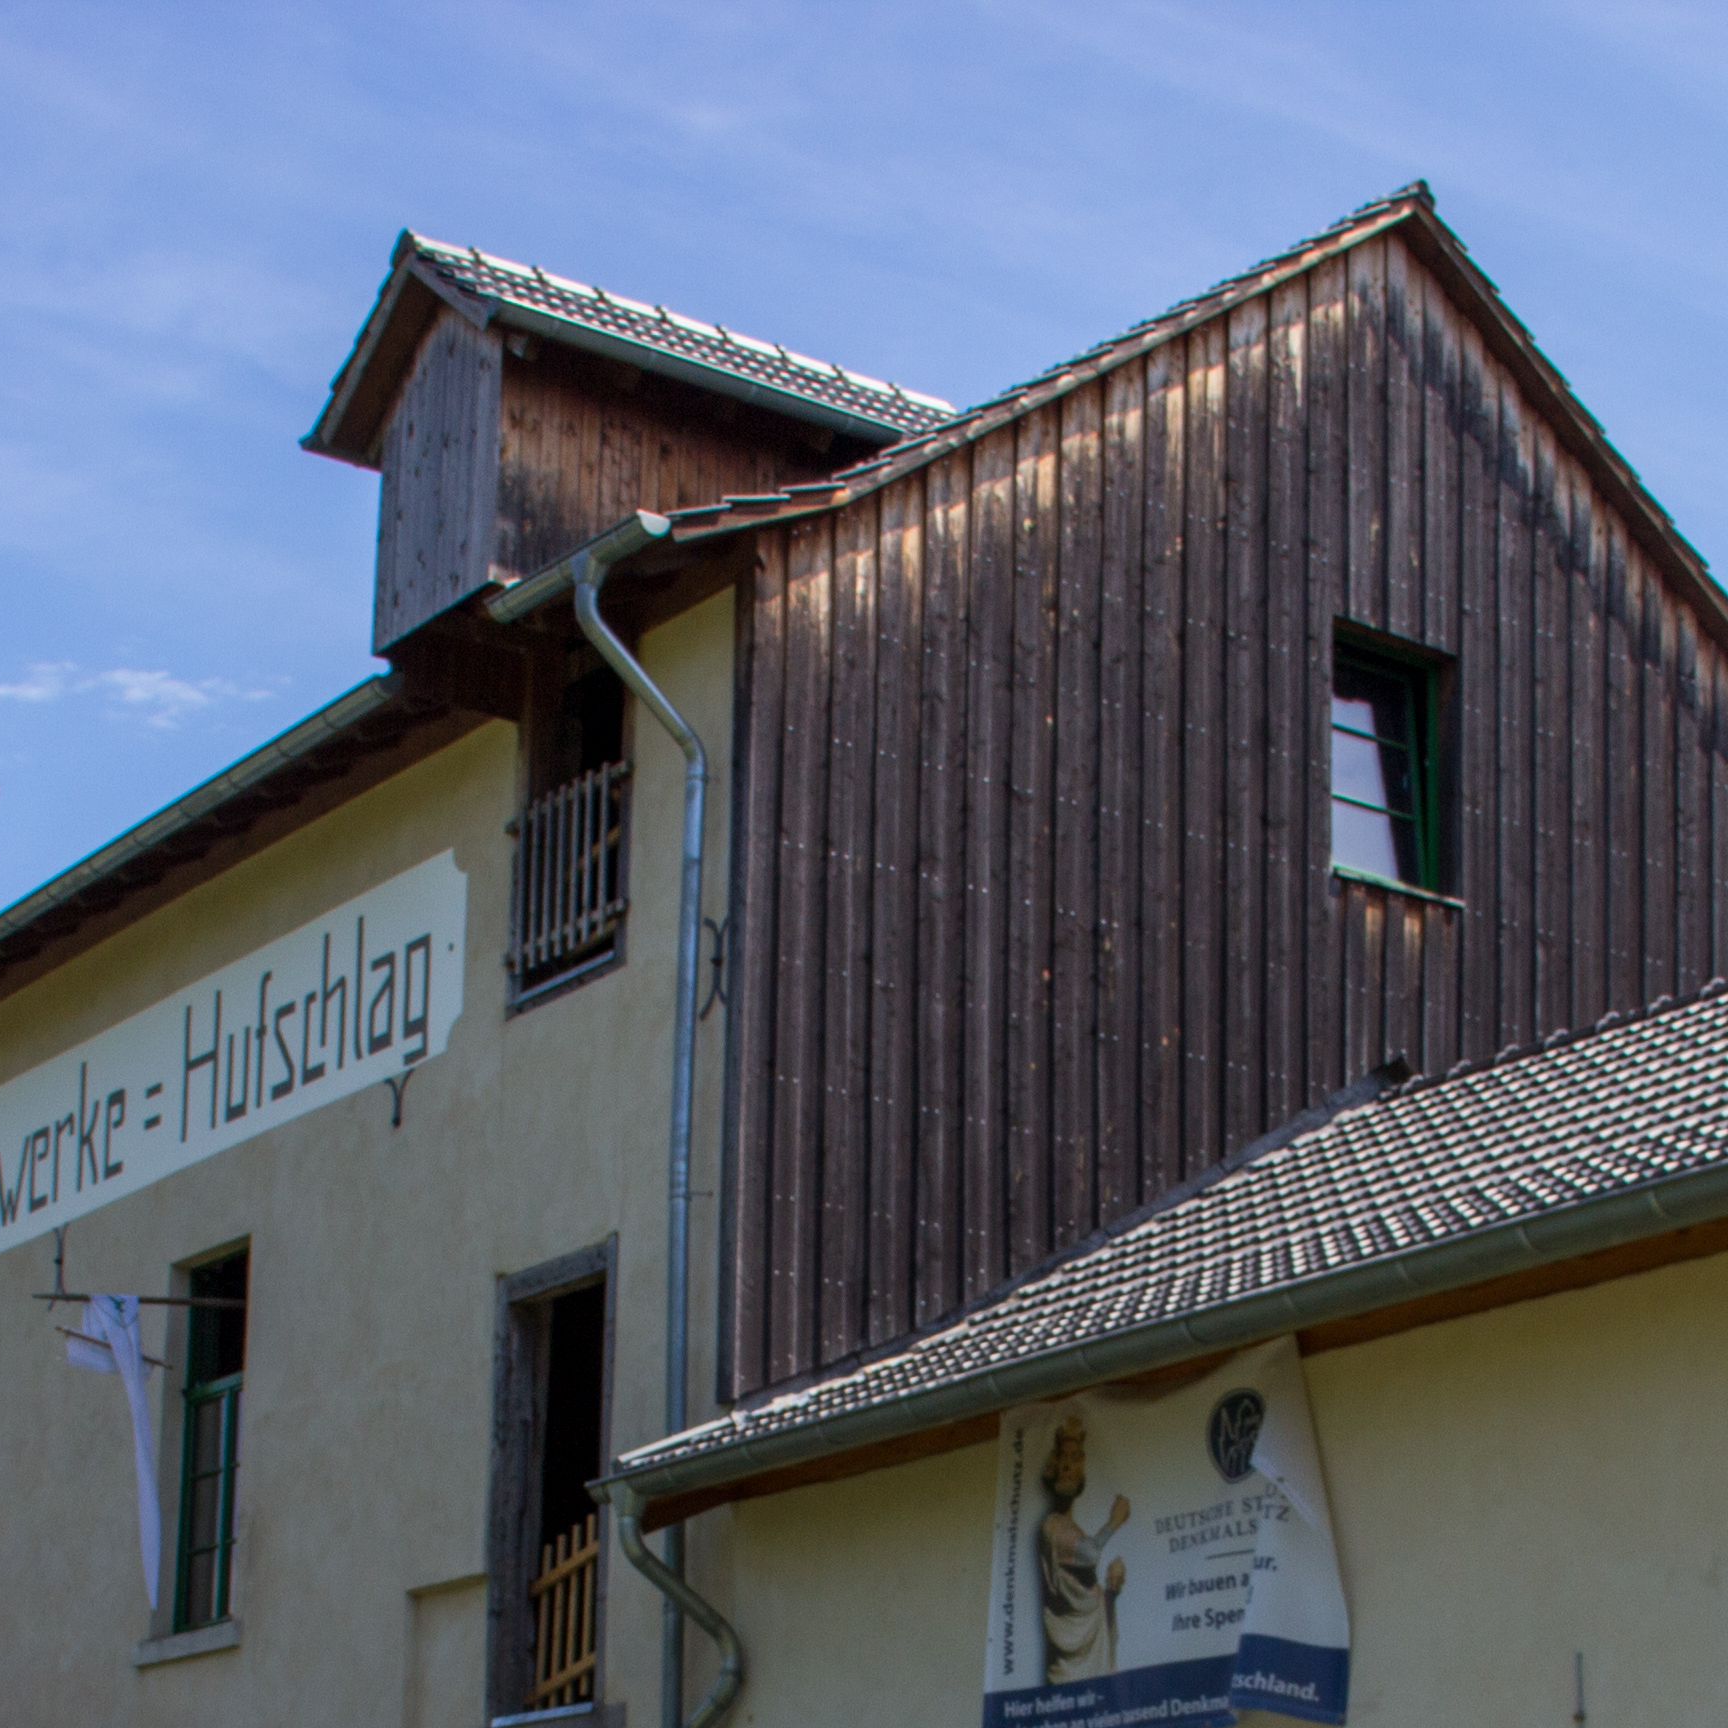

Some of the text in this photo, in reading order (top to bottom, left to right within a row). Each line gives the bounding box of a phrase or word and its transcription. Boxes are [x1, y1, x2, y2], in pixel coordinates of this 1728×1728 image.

[179, 915, 432, 1144] Hufschlag
[1003, 1428, 1023, 1676] www.denkmalschutz.de
[1188, 1573, 1237, 1596] bauen
[1004, 1700, 1032, 1718] Hier
[1035, 1694, 1075, 1715] helfen
